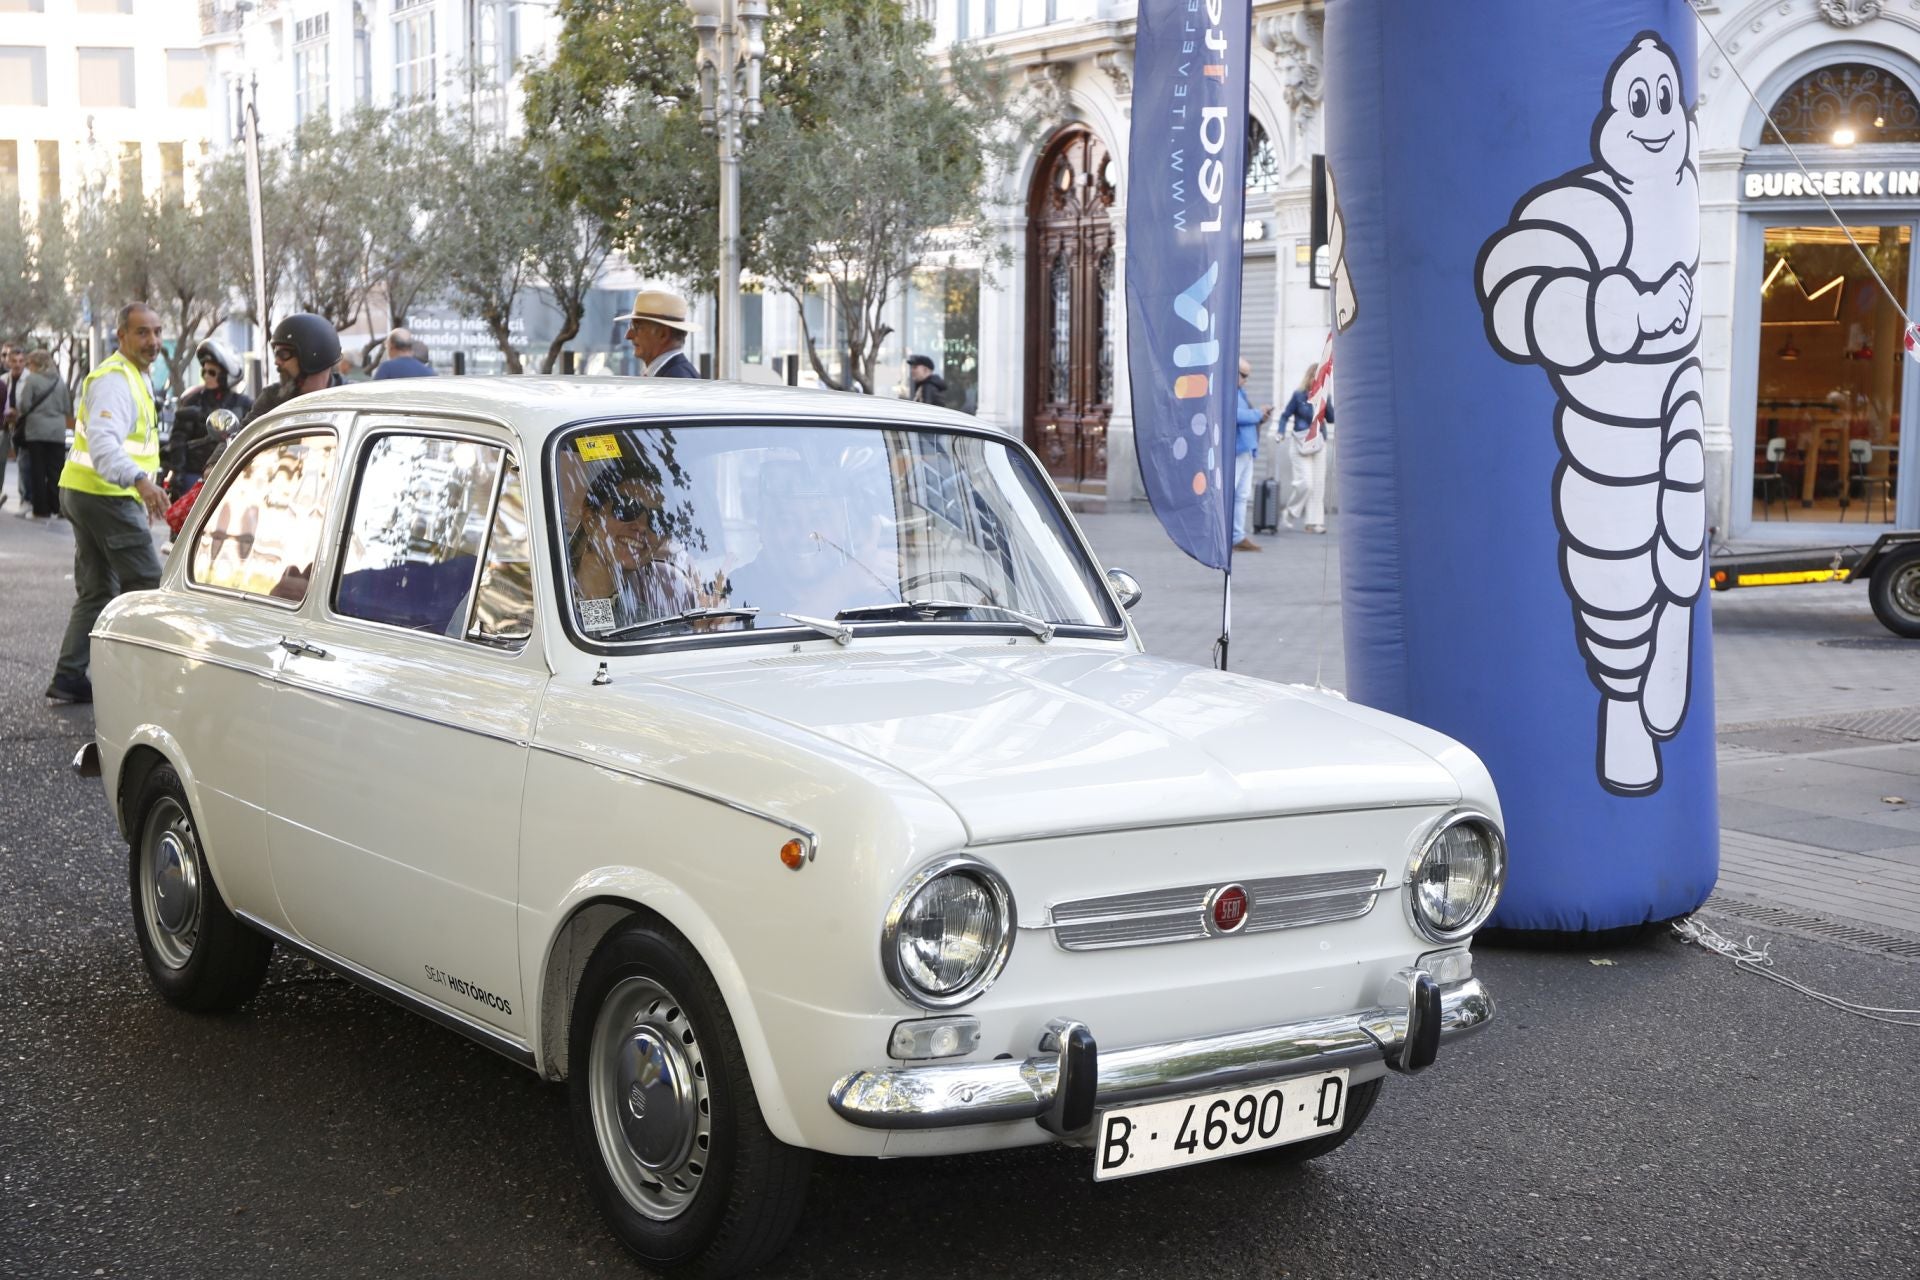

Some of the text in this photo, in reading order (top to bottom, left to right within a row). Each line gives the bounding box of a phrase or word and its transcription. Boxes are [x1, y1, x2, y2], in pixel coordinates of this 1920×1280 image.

[1745, 170, 1920, 197] BURGER KIN
[406, 315, 440, 330] Todo
[443, 319, 460, 330] es
[1221, 899, 1241, 920] SEAT
[424, 965, 512, 1015] SEAT HISTÓRICOS
[1173, 1089, 1284, 1155] 4690
